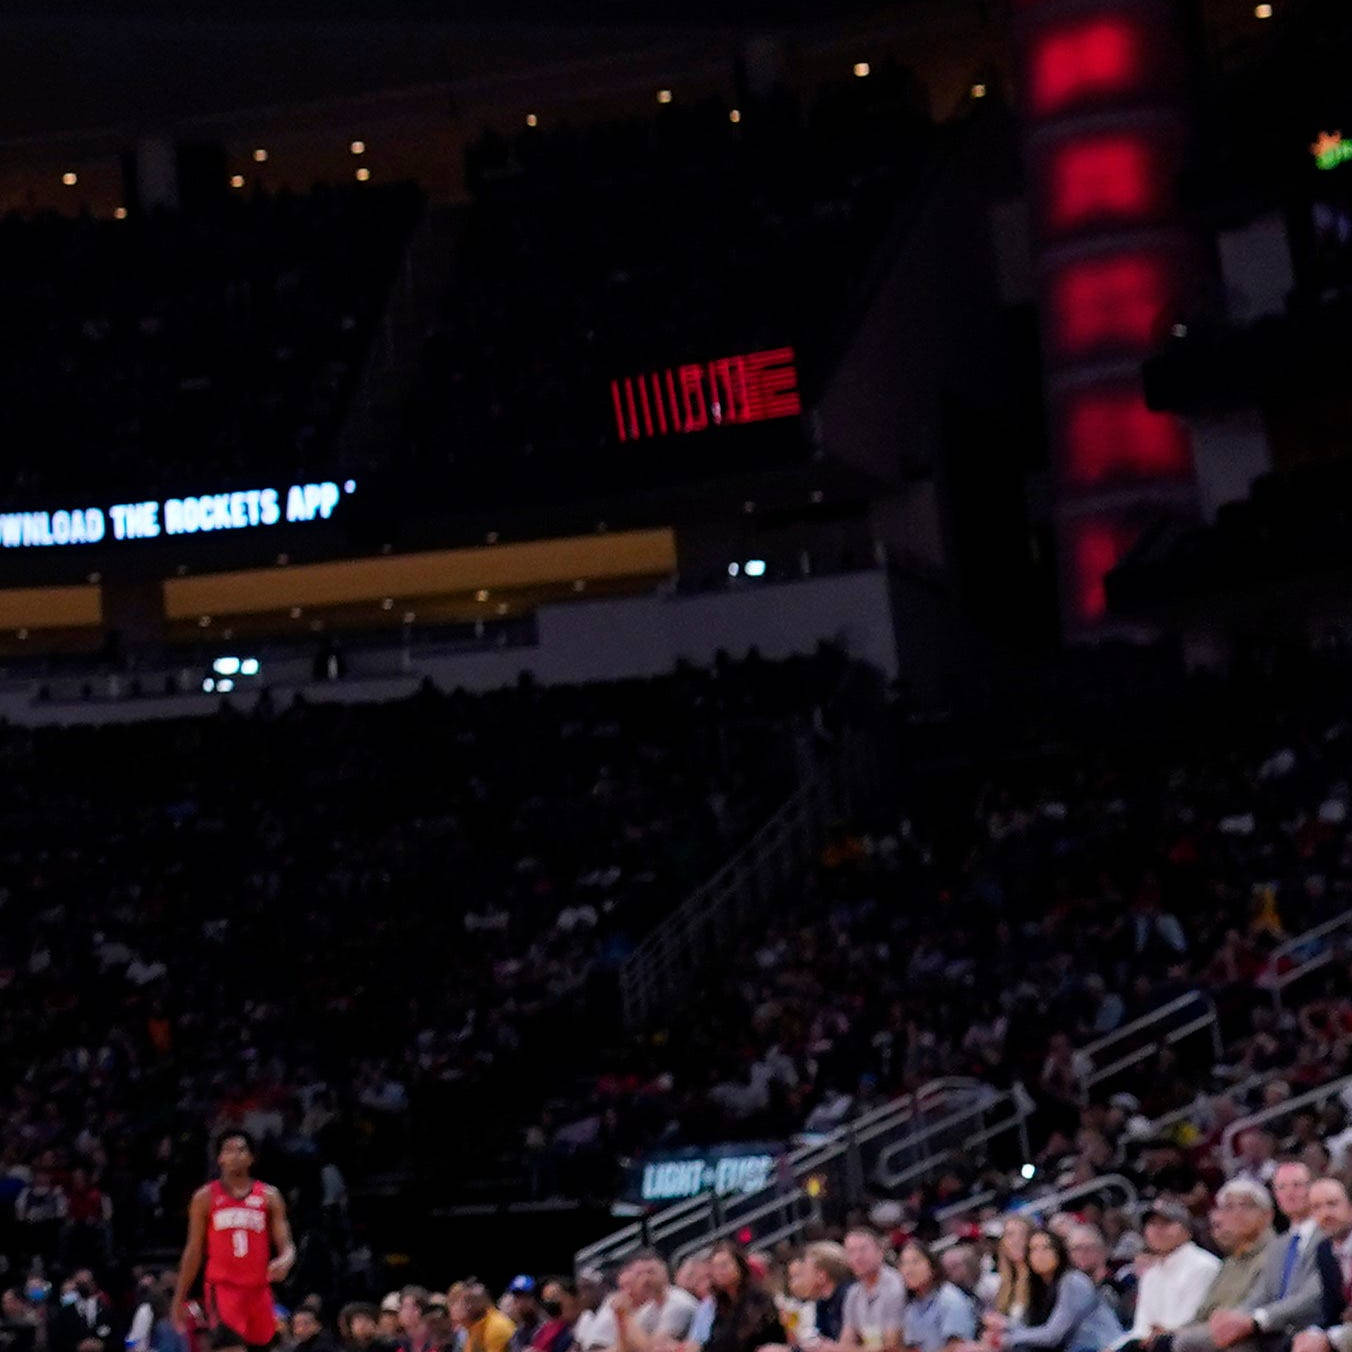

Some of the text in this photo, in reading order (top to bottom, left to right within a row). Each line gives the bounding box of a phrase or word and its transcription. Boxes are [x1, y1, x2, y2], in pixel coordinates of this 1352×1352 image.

[109, 500, 160, 541] THE
[163, 488, 281, 535] ROCKETS
[286, 481, 340, 522] APP
